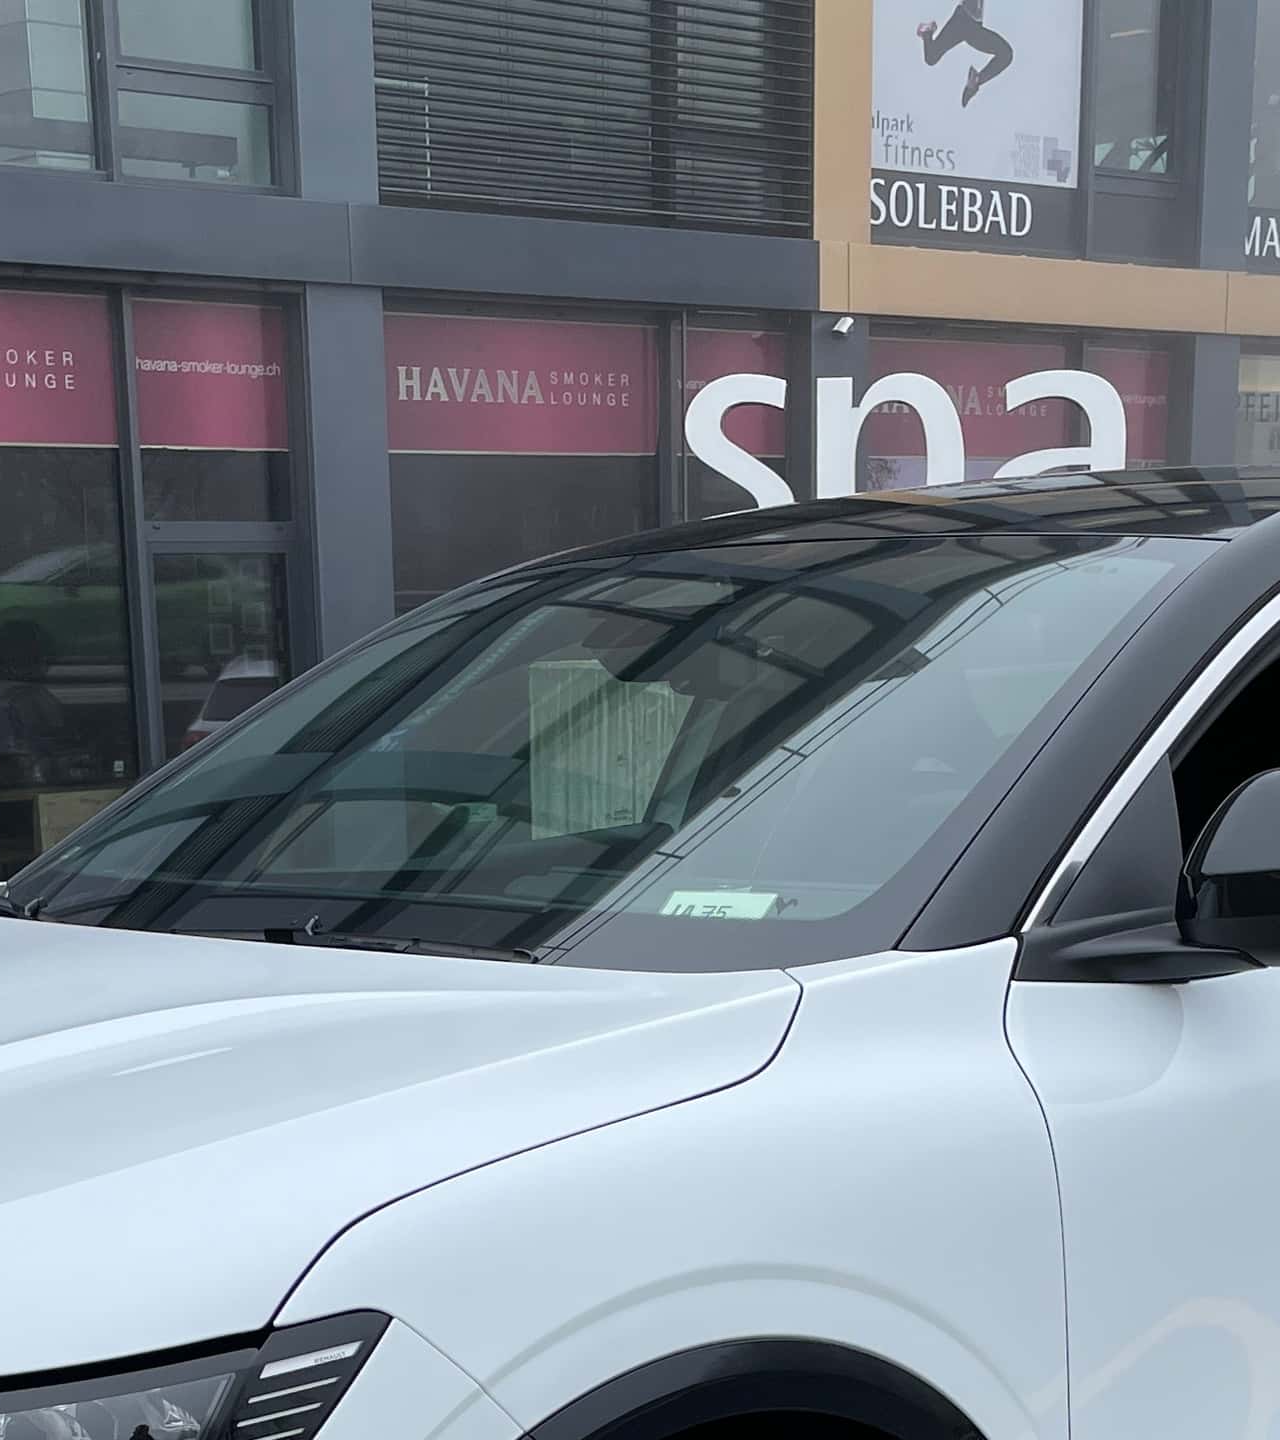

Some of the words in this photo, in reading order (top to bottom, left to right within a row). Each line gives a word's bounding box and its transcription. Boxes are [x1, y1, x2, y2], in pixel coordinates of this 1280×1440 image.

[872, 110, 914, 137] lpark
[883, 134, 956, 172] fitness
[870, 178, 1033, 237] SOLEBAD
[135, 356, 281, 380] havana-smoker-lounge.ch
[549, 370, 630, 387] SMOKER
[396, 366, 545, 405] HAVANA
[549, 391, 630, 408] LOUNGE
